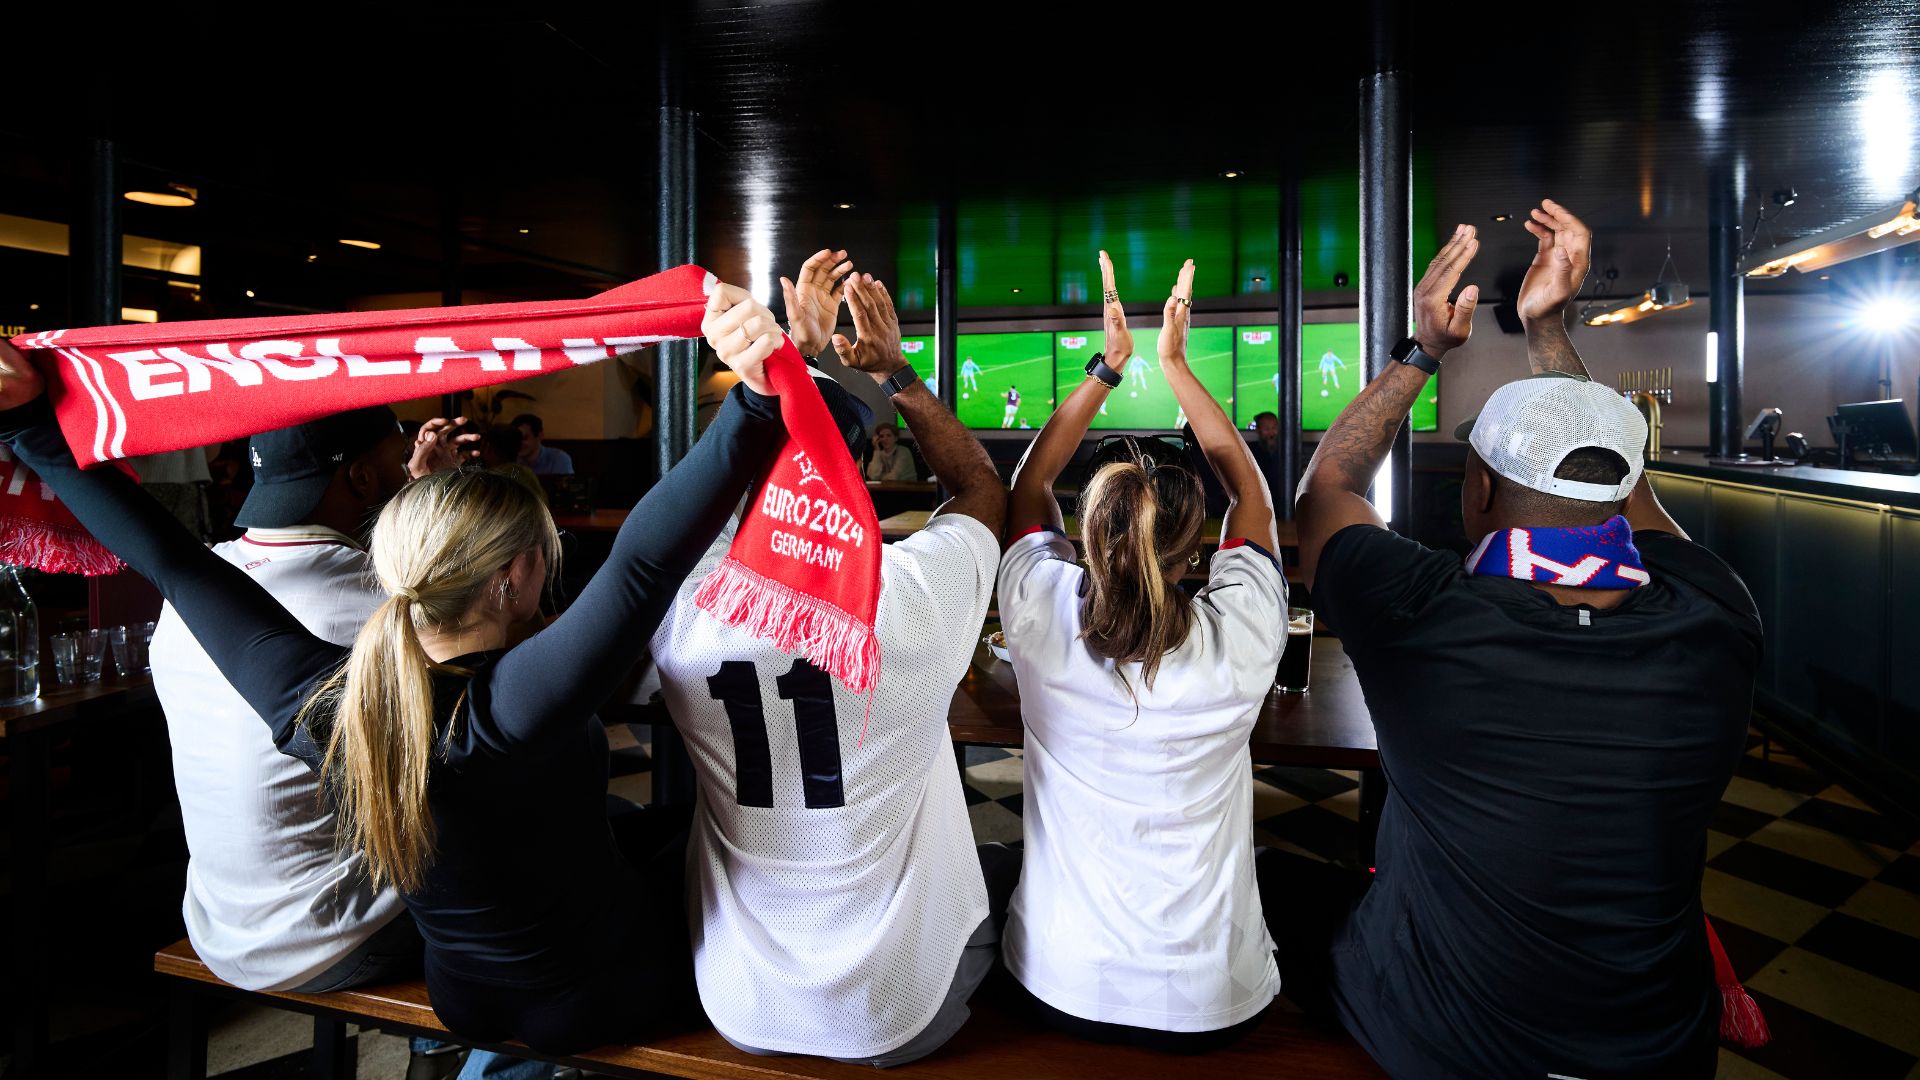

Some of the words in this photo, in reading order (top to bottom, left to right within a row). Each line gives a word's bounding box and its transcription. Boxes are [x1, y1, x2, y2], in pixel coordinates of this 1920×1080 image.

[251, 446, 262, 467] LA
[762, 482, 811, 527] EURO
[813, 499, 864, 547] 2024
[771, 529, 843, 572] GERMANY
[706, 658, 845, 809] 11
